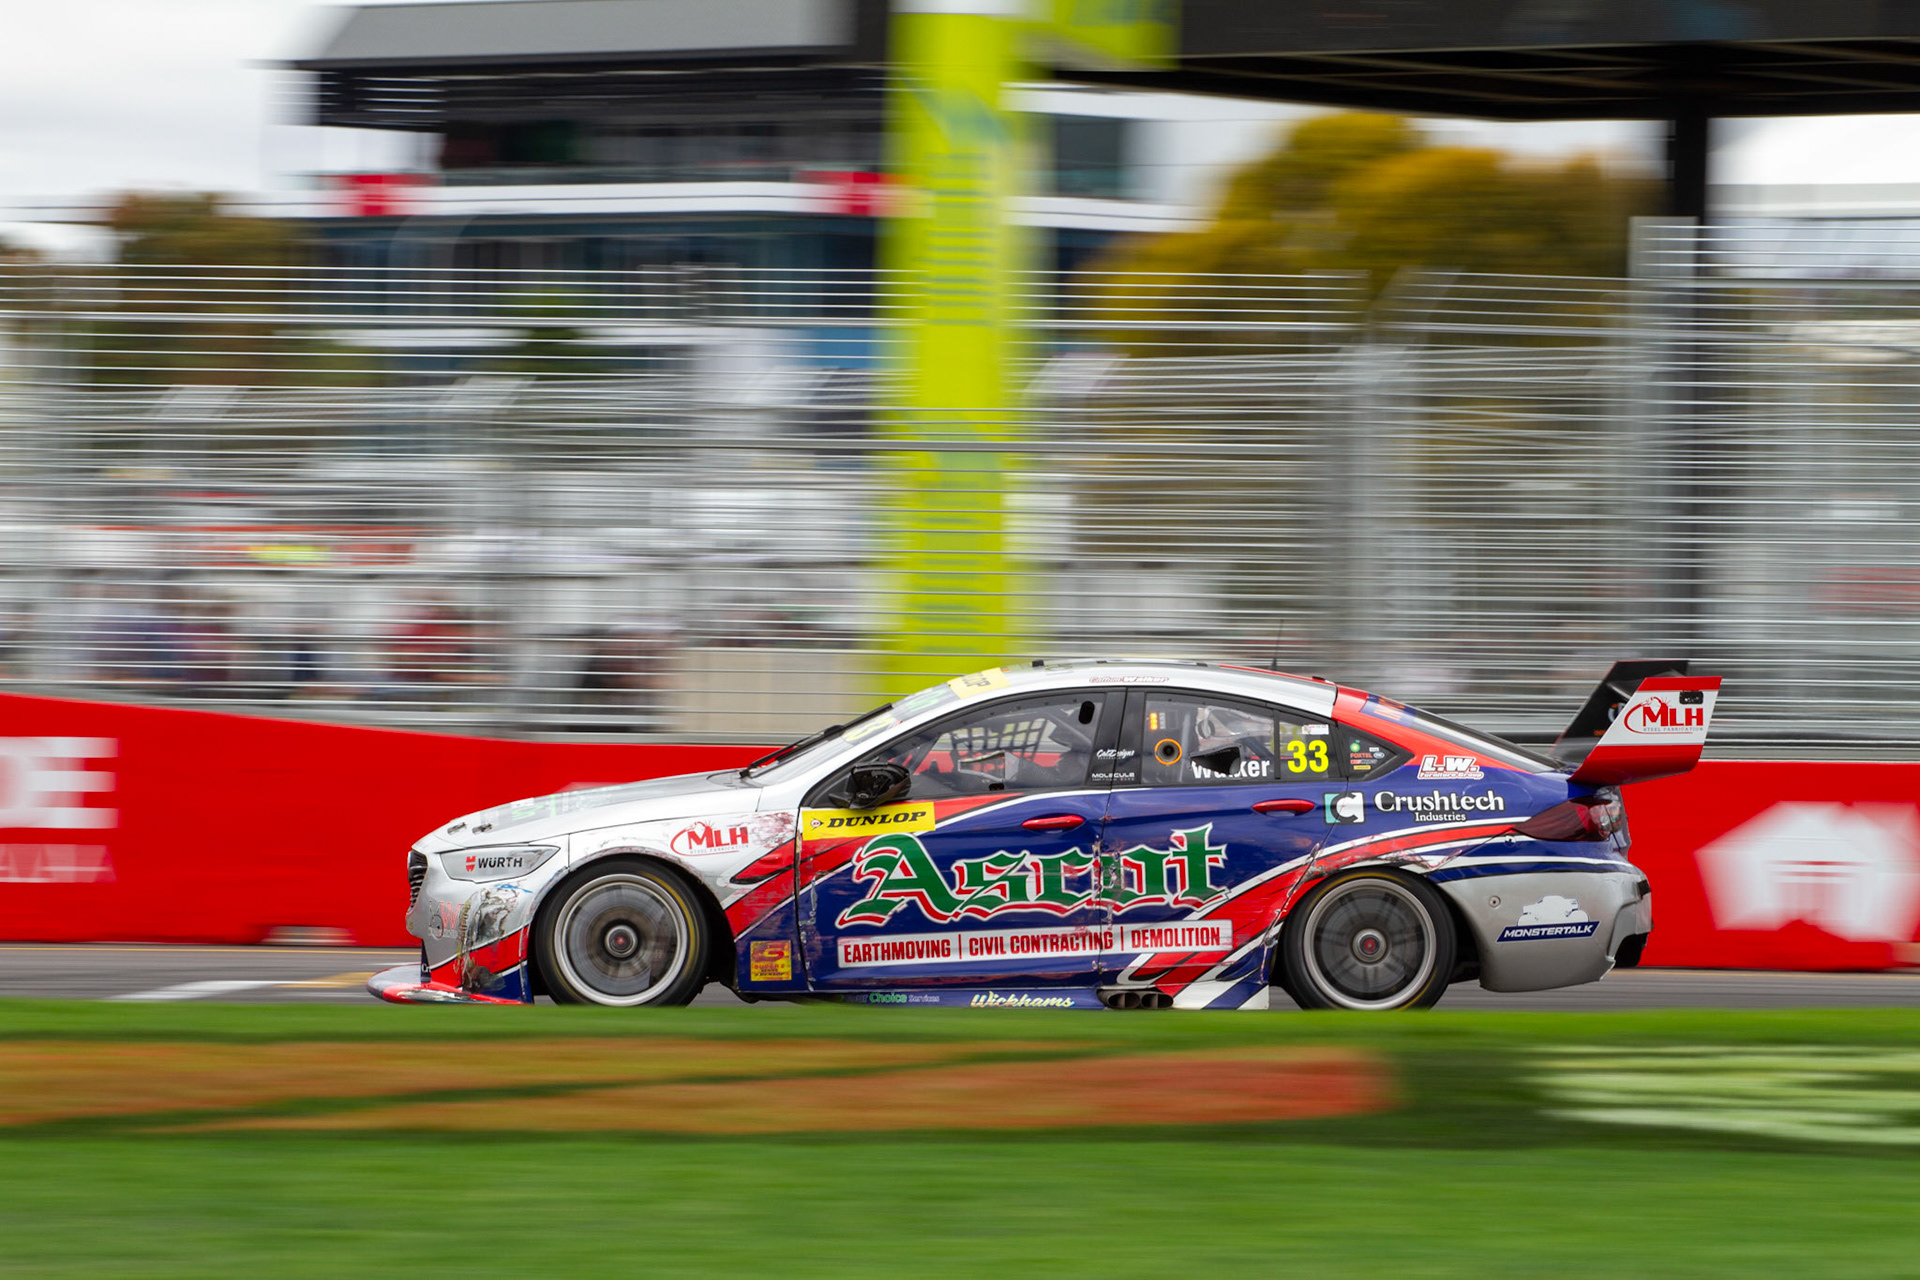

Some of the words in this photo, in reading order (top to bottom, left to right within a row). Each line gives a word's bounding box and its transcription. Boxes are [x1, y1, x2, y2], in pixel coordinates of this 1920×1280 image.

[1643, 702, 1704, 727] MLH
[1287, 740, 1330, 773] 33
[1374, 790, 1505, 812] Crushtech
[827, 811, 927, 828] DUNLOP
[1414, 812, 1467, 822] Industries
[687, 826, 749, 850] MLH
[478, 857, 523, 868] WÜRTH
[835, 822, 1231, 930] Ascot
[1503, 925, 1593, 938] MONSTERTALK
[844, 939, 951, 963] EARTHMOVING
[969, 936, 1007, 957] CIVIL
[1010, 931, 1114, 954] CONTRACTING
[1131, 927, 1221, 948] DEMOLITION
[869, 992, 907, 1003] Choice
[908, 994, 940, 1003] Services
[970, 990, 1076, 1007] Wickhams
